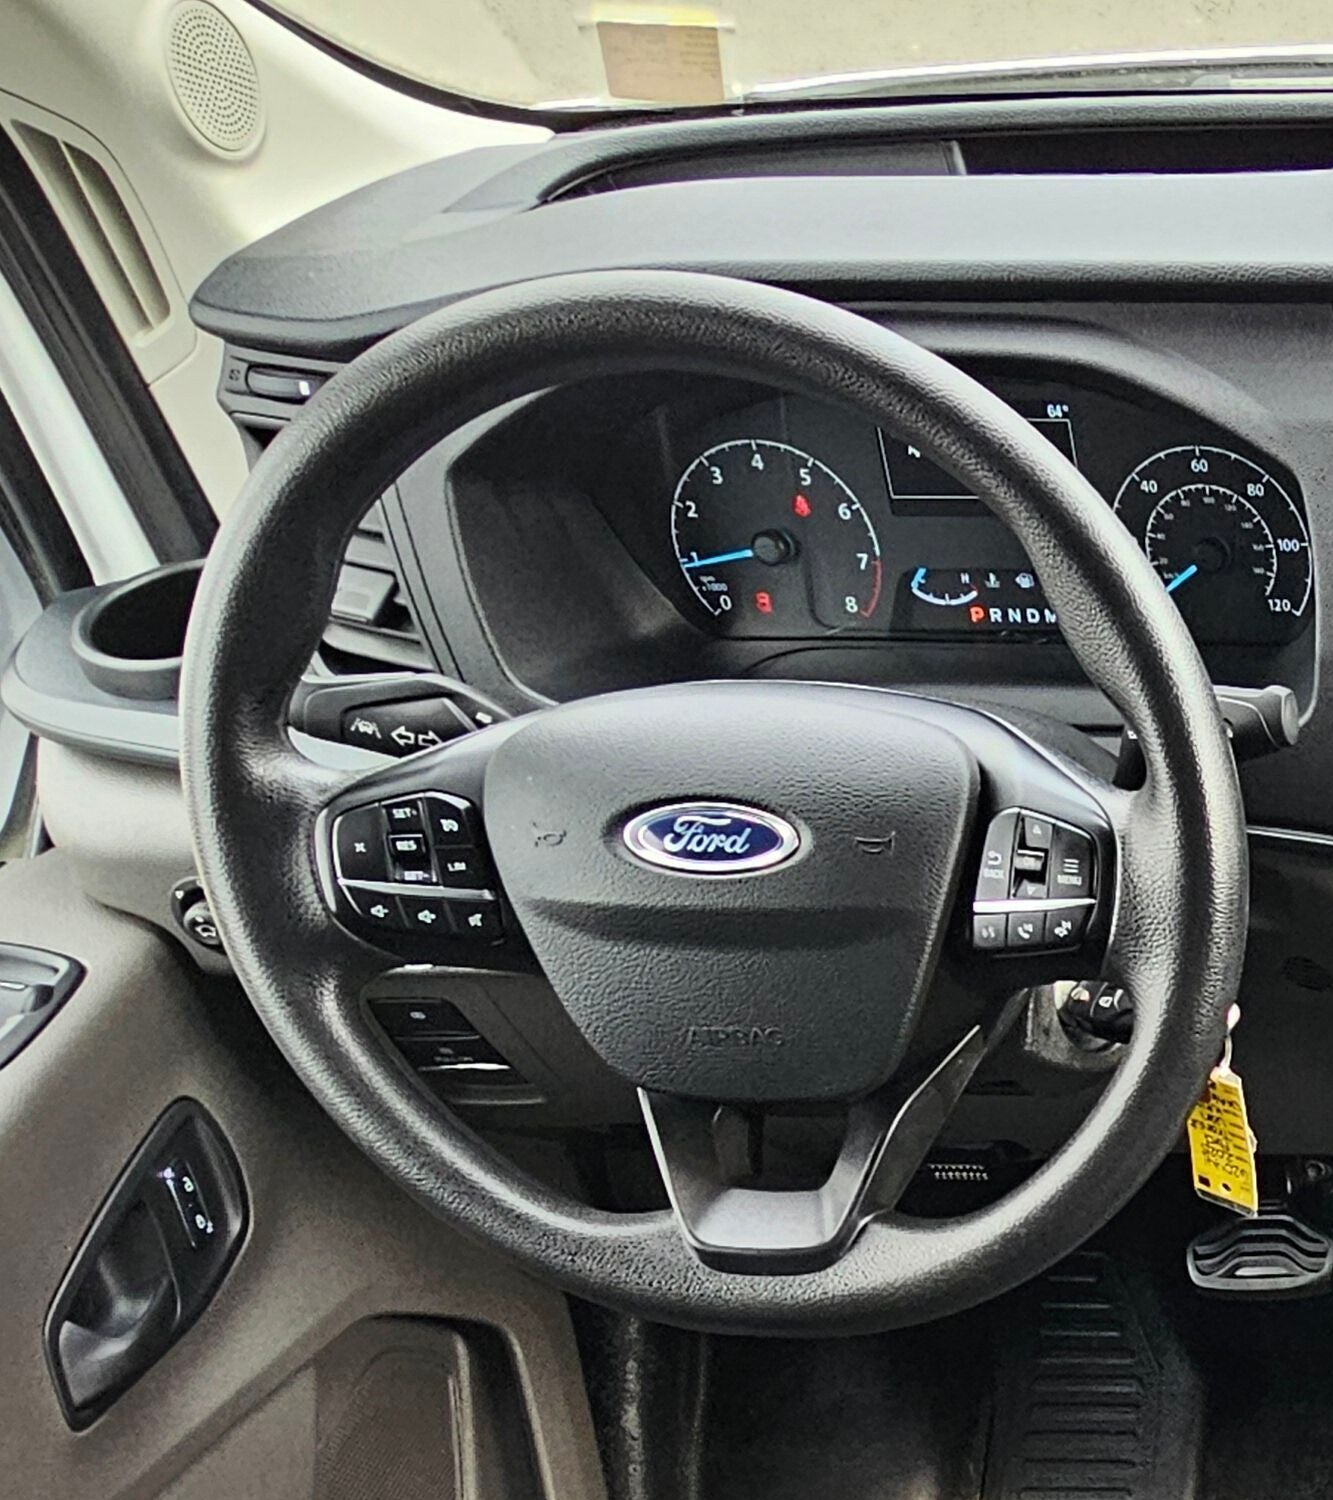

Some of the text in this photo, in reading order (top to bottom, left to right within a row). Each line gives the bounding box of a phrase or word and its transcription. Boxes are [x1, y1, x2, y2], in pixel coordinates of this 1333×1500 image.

[751, 454, 764, 470] 4
[1191, 459, 1208, 473] 60
[710, 467, 723, 485] 3
[800, 469, 812, 486] 5
[1140, 480, 1158, 493] 40
[1247, 483, 1264, 497] 80
[685, 501, 698, 518] 2
[838, 503, 851, 520] 6
[1277, 538, 1300, 552] 100
[856, 554, 868, 570] 7
[720, 595, 732, 611] 0
[845, 596, 858, 613] 8
[1268, 599, 1291, 612] 120
[969, 607, 985, 623] P
[989, 608, 1002, 623] R
[1008, 608, 1021, 623] N
[1026, 609, 1040, 623] D
[663, 816, 752, 854] Ford
